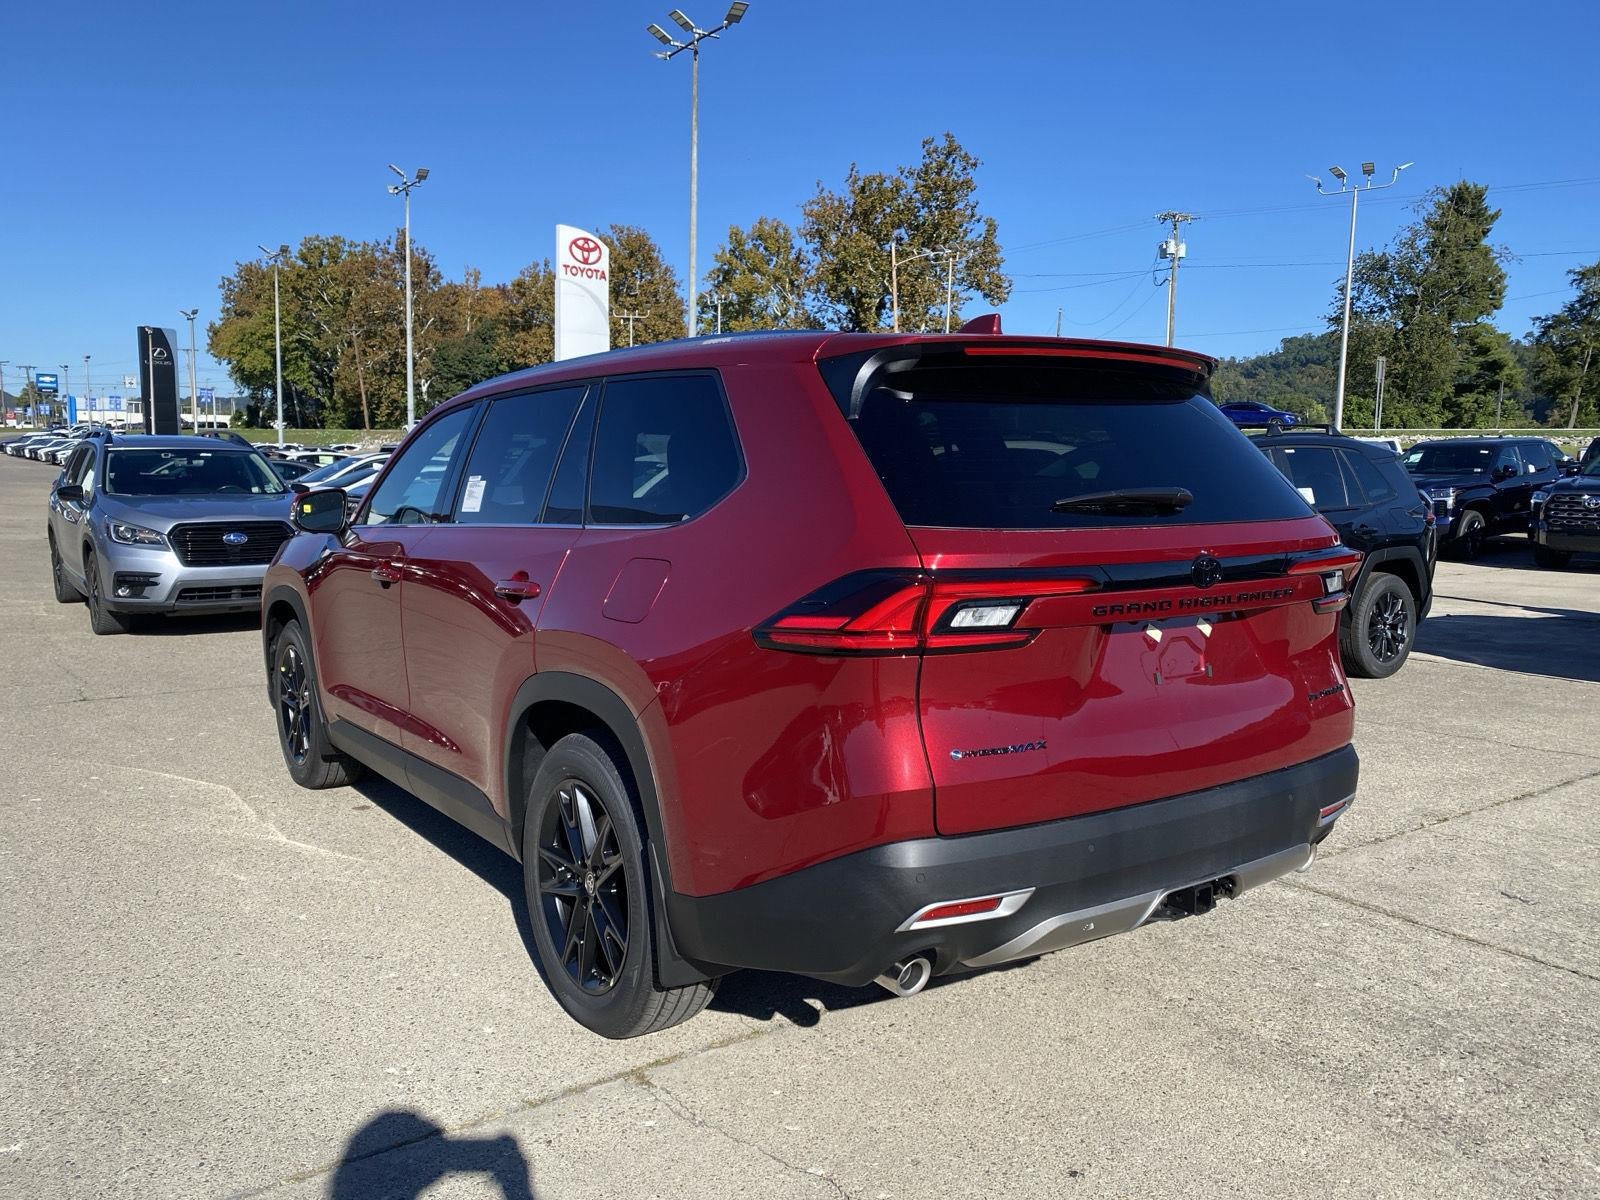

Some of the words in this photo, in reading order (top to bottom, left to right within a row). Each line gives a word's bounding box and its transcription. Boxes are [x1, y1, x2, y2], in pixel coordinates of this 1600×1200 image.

[562, 264, 607, 281] TOYOTA
[1092, 600, 1172, 617] GRAND
[1178, 587, 1295, 609] HIGHLANDER
